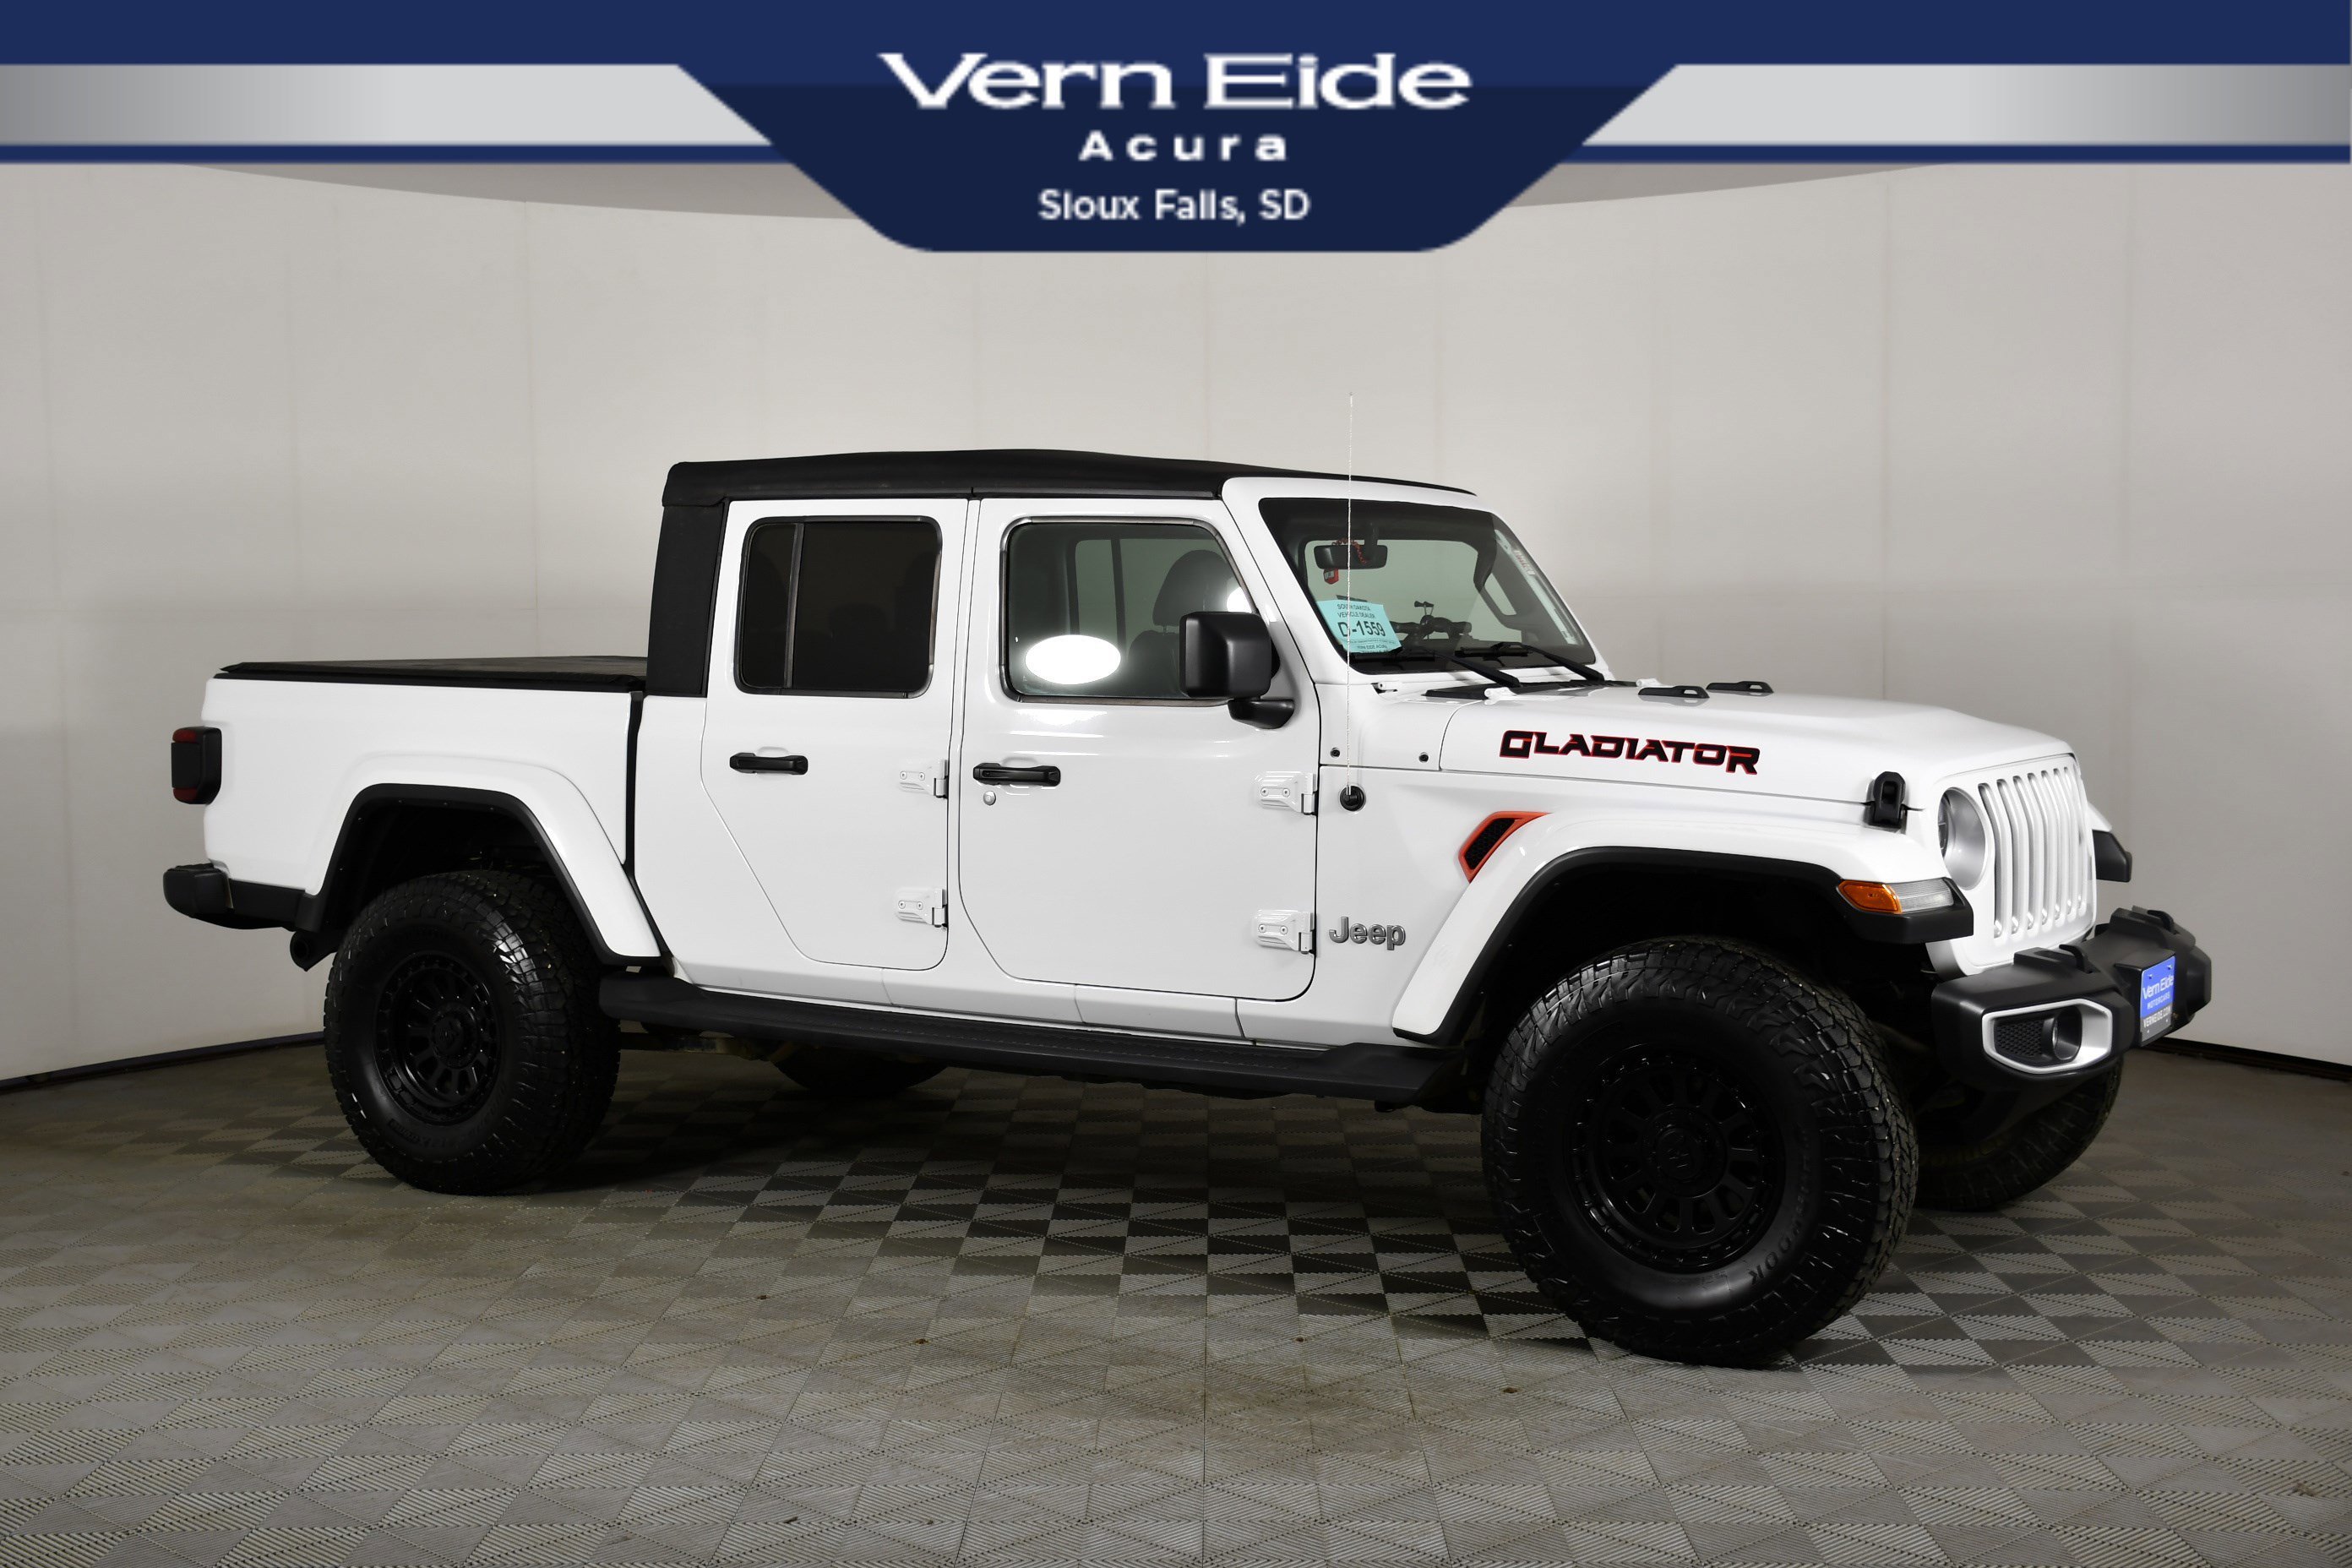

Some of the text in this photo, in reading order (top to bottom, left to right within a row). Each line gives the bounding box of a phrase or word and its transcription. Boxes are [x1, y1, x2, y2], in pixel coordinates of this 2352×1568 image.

[1337, 620, 1386, 637] D-1559
[1499, 729, 1761, 776] GLADIATOR
[1328, 916, 1407, 951] Jeep
[2142, 974, 2174, 999] Vern Eide
